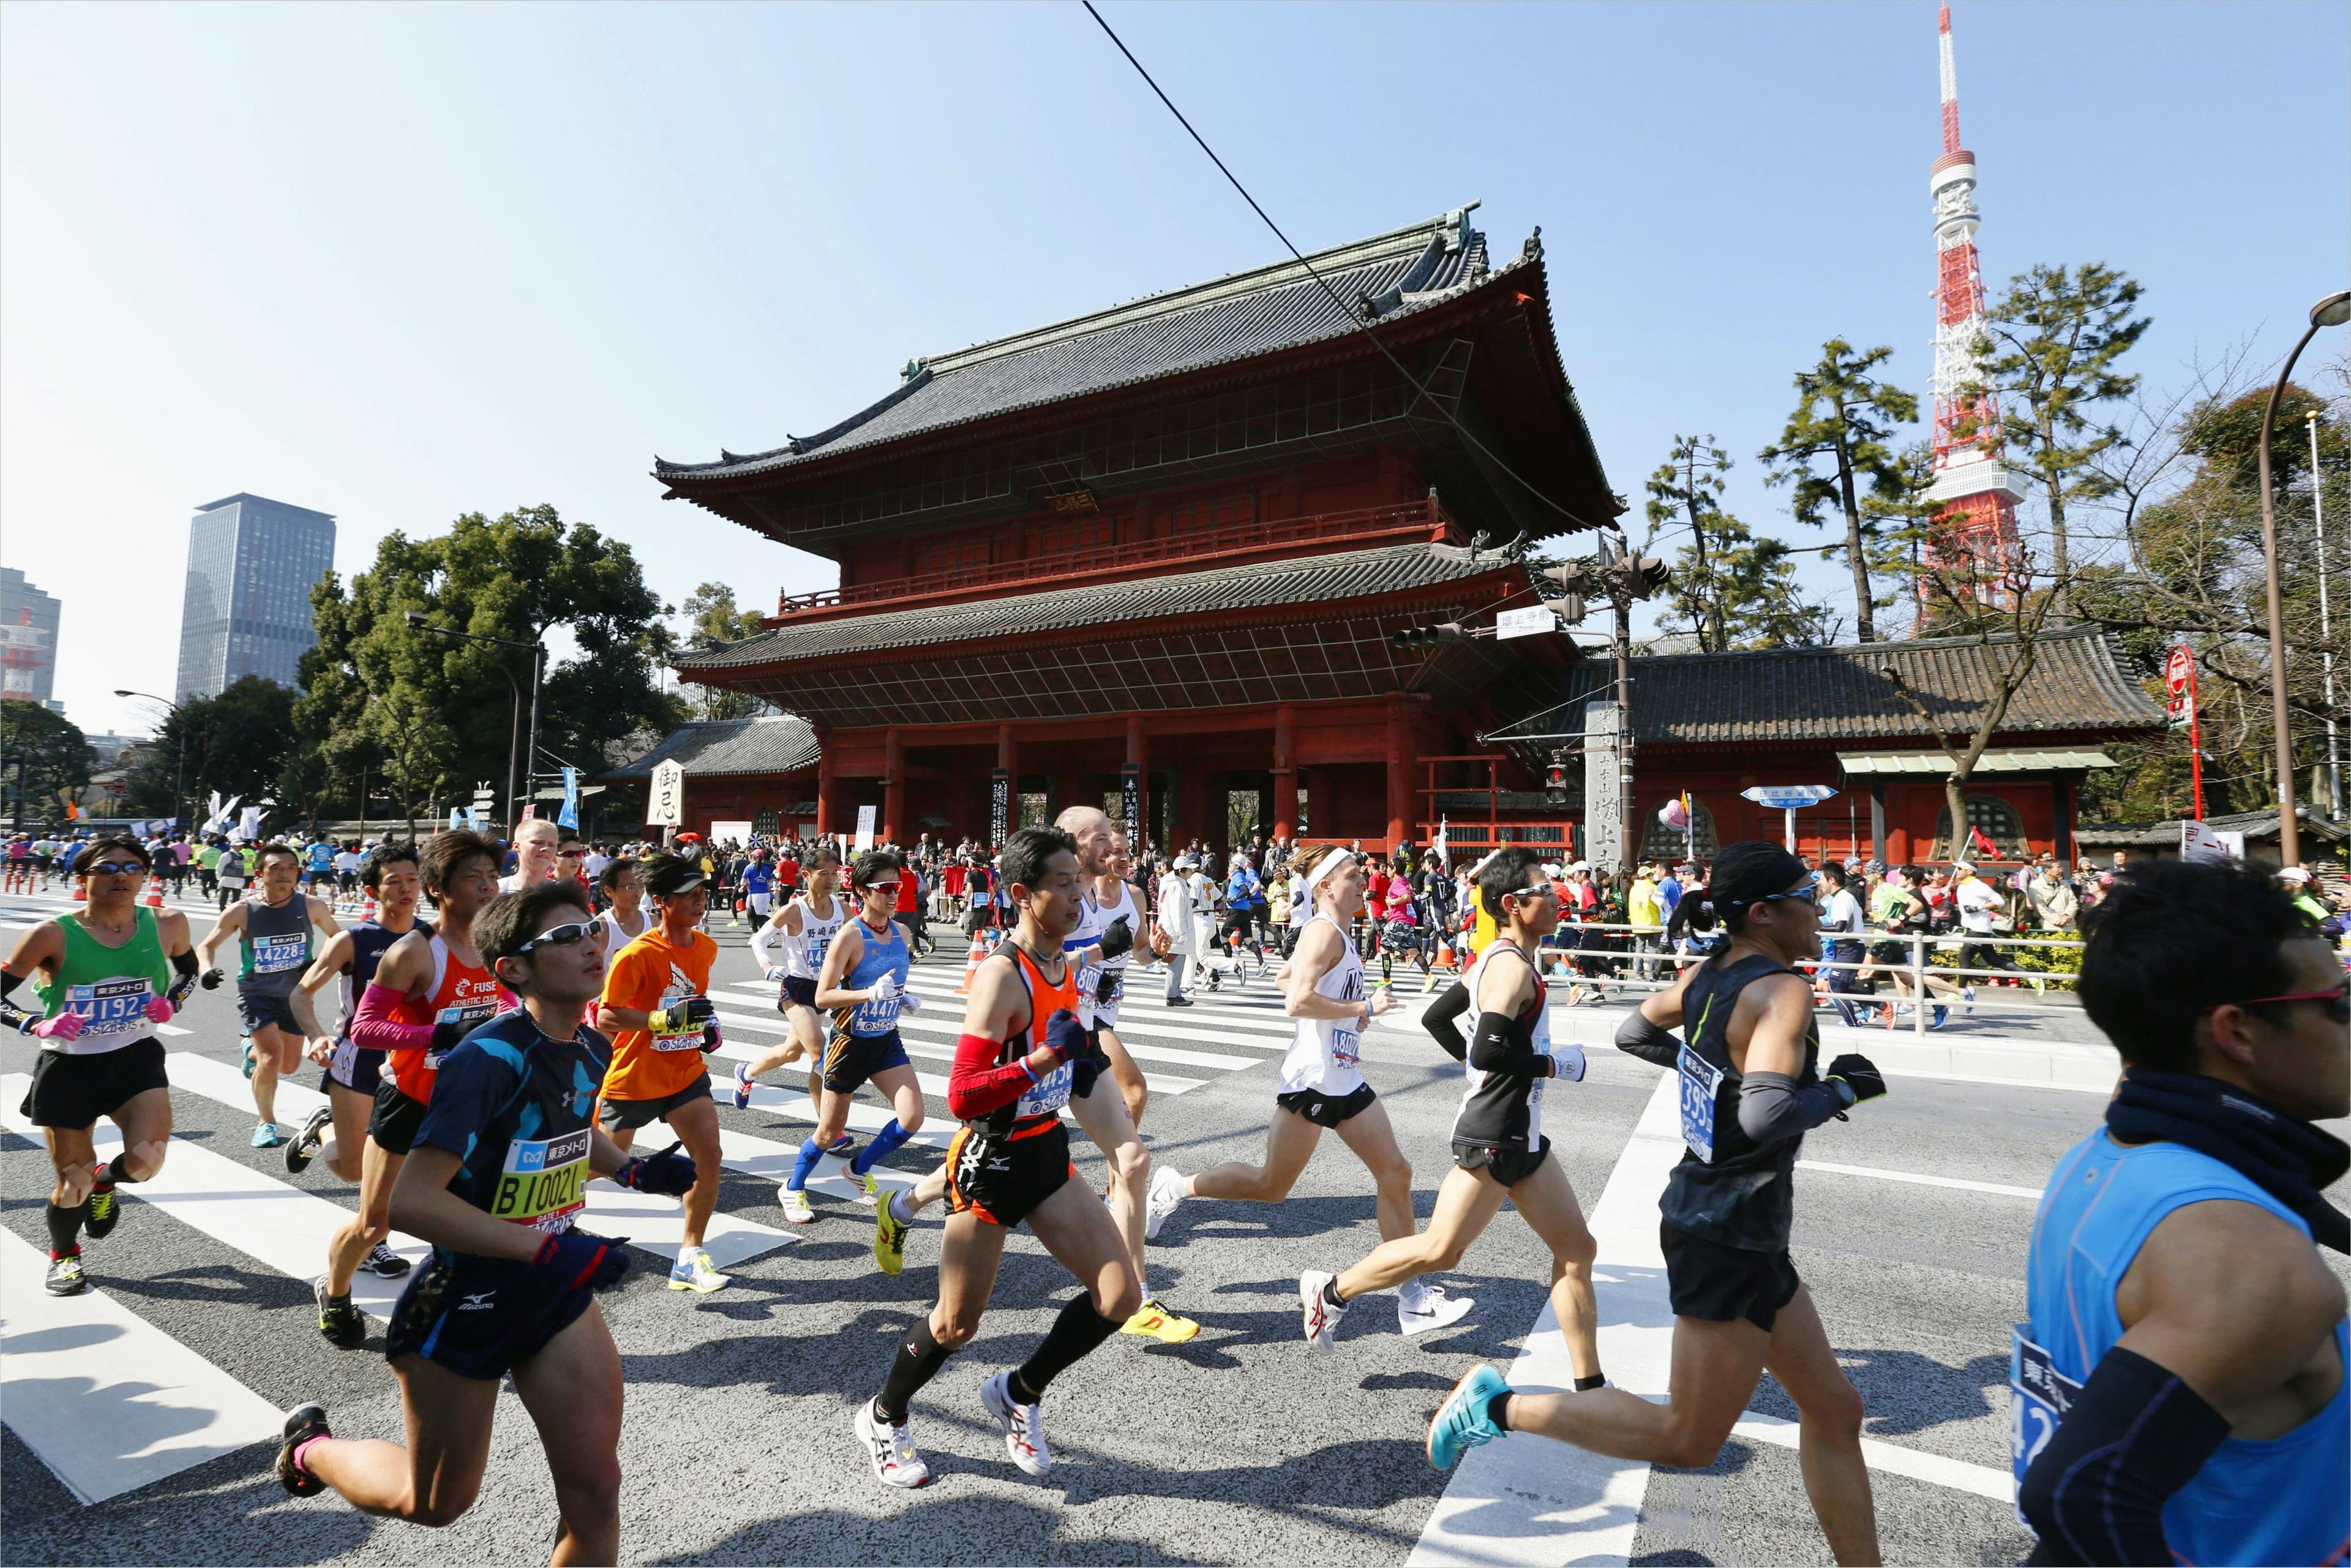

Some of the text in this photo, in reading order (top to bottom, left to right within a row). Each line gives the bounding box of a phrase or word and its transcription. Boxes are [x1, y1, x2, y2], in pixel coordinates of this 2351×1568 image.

[1502, 609, 1549, 626] 増上寺前
[657, 765, 678, 820] 御忌
[1437, 881, 1445, 899] 17
[254, 945, 298, 962] A4228
[97, 983, 143, 995] 東京メトロ
[473, 981, 497, 993] FUSE
[68, 996, 140, 1019] A4192
[449, 994, 498, 1008] ATHLETIC CLUB
[859, 999, 900, 1018] A4477
[462, 1005, 496, 1020] 東京メトロ
[1685, 1054, 1711, 1085] 東京メトロ
[547, 1138, 586, 1161] 東京メトロ
[495, 1164, 578, 1215] B10021
[537, 1212, 556, 1223] GATE
